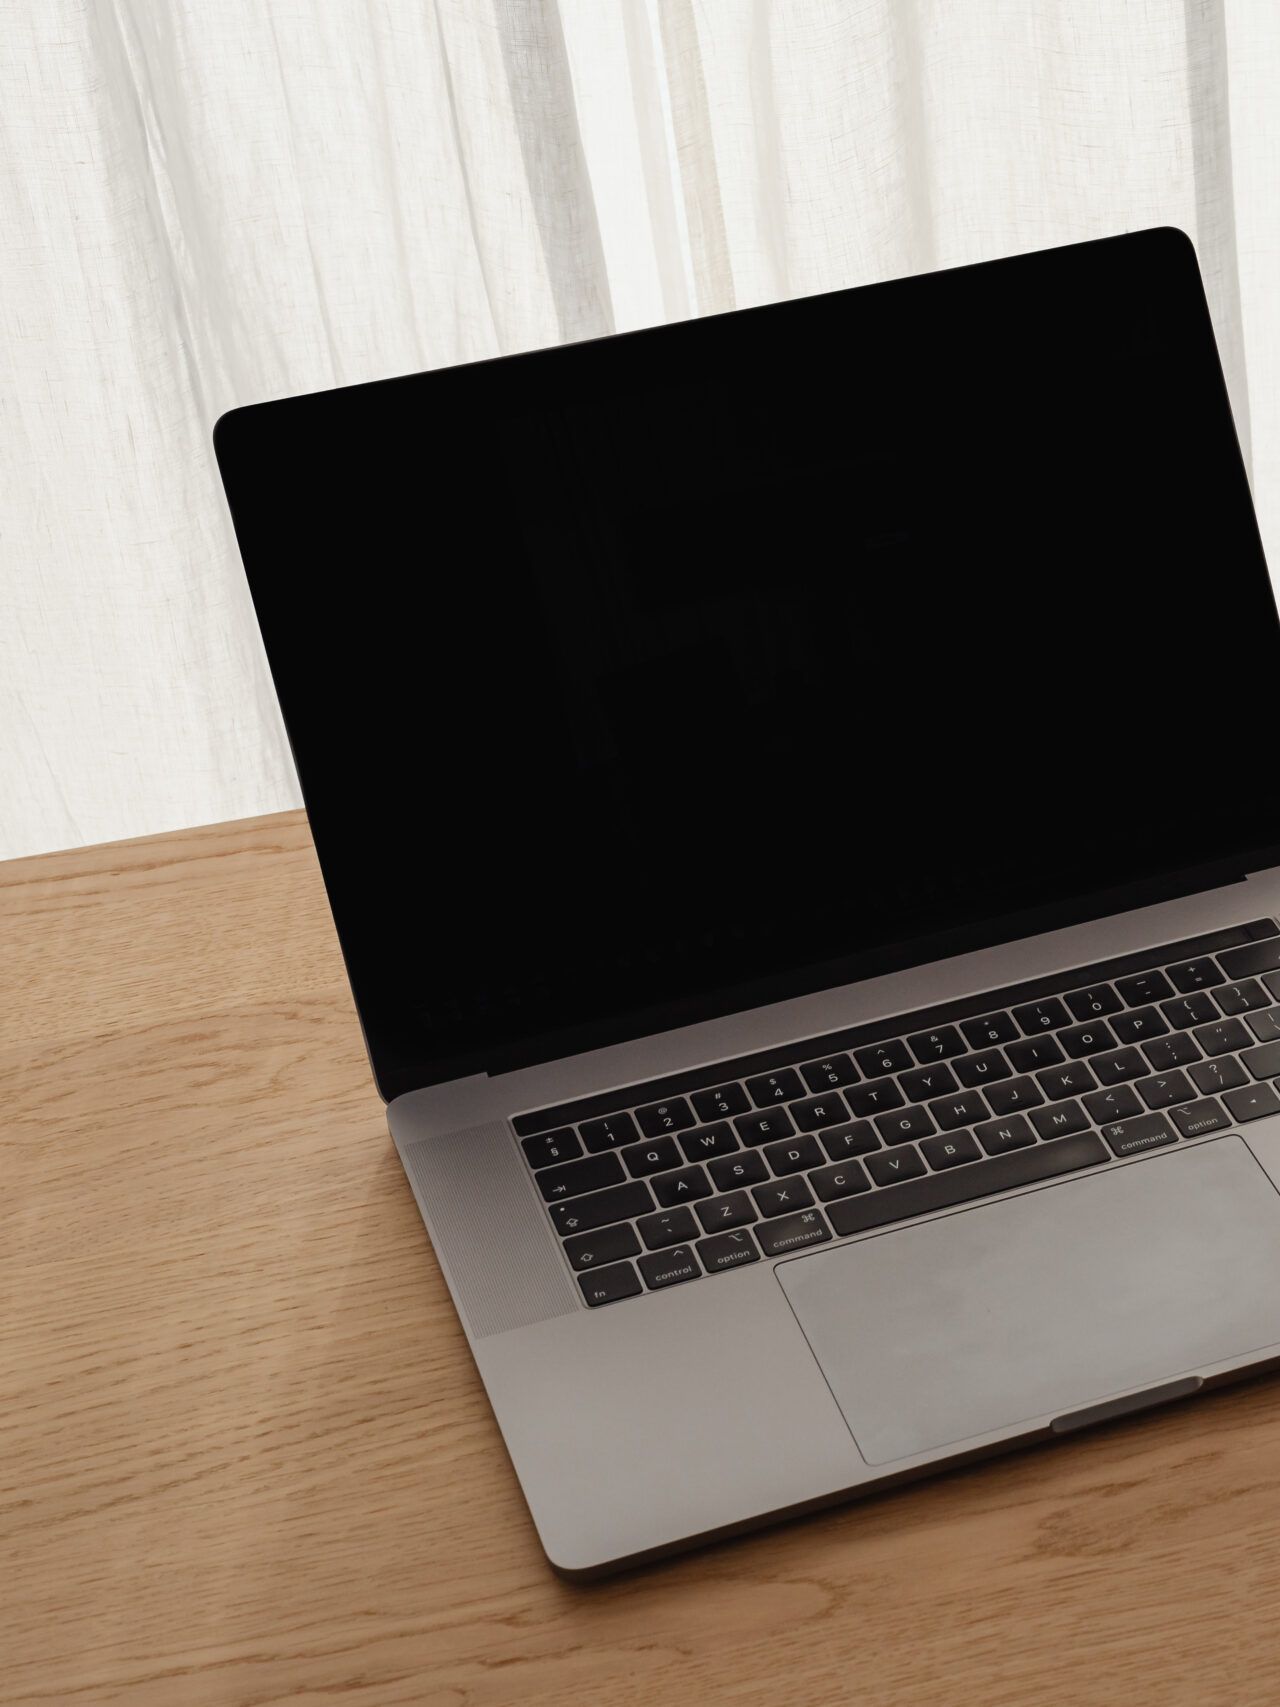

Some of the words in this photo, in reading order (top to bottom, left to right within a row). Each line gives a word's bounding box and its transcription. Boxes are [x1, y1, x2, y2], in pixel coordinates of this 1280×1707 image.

[1041, 1017, 1050, 1025] 9
[1134, 1021, 1142, 1029] P
[989, 1031, 998, 1039] 8
[1082, 1035, 1092, 1043] O
[936, 1045, 942, 1053] 7
[883, 1059, 892, 1067] 6
[976, 1064, 987, 1072] U
[829, 1074, 838, 1082] 5
[923, 1078, 930, 1086] Y
[1061, 1076, 1072, 1085] K
[775, 1088, 783, 1096] 4
[869, 1092, 877, 1100] T
[1012, 1091, 1018, 1099] J
[719, 1103, 728, 1111] 3
[954, 1105, 966, 1114] H
[814, 1108, 825, 1116] R
[664, 1118, 673, 1126] 2
[1053, 1114, 1066, 1124] M
[760, 1122, 769, 1130] E
[900, 1120, 911, 1129] G
[1187, 1116, 1219, 1132] option
[999, 1130, 1011, 1139] N
[701, 1136, 714, 1146] W
[845, 1136, 853, 1144] F
[1120, 1130, 1168, 1150] command
[945, 1145, 955, 1154] B
[647, 1152, 659, 1161] Q
[788, 1151, 799, 1160] D
[889, 1160, 898, 1168] V
[734, 1166, 744, 1174] S
[835, 1176, 845, 1185] C
[678, 1182, 688, 1190] A
[777, 1191, 789, 1200] X
[721, 1207, 732, 1216] Z
[773, 1228, 824, 1249] command
[717, 1250, 751, 1266] option
[655, 1265, 693, 1282] control
[594, 1290, 606, 1299] fn
